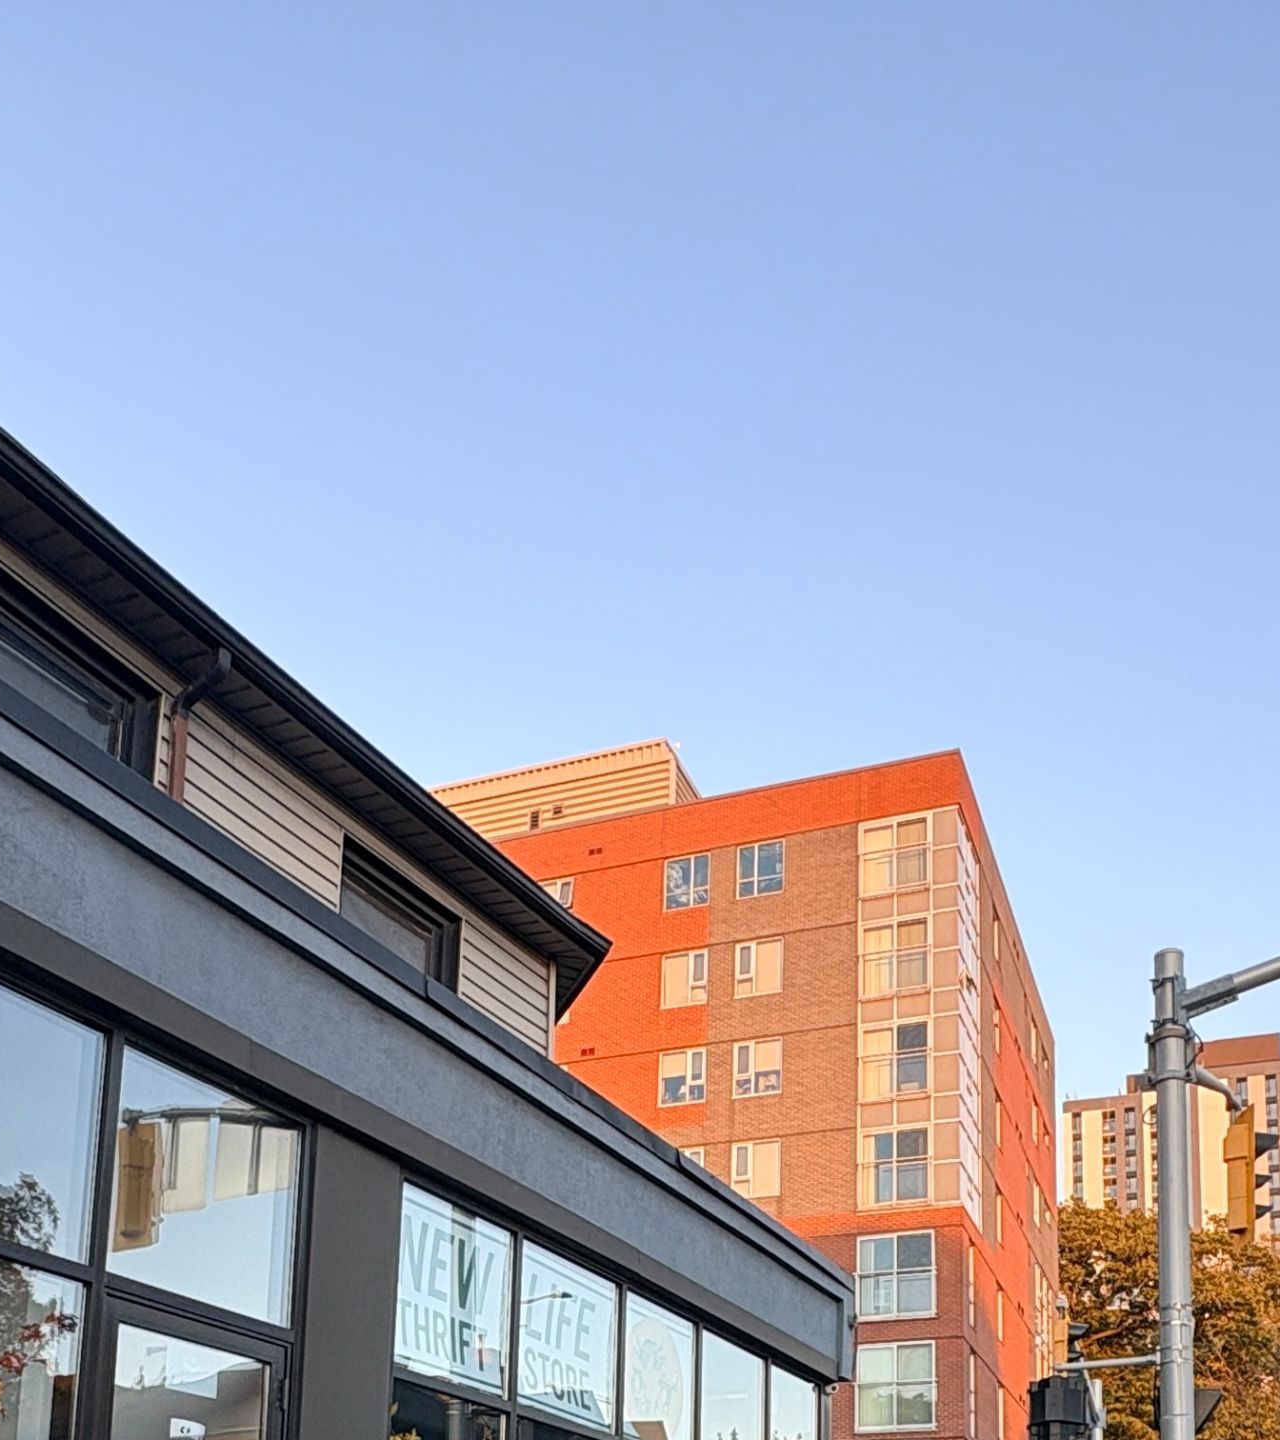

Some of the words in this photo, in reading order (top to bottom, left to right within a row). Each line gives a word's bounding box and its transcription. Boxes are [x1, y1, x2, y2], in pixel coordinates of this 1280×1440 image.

[400, 1213, 495, 1316] NEW
[524, 1272, 596, 1363] LIFE
[400, 1298, 488, 1372] THRIFT
[523, 1346, 592, 1412] STORE
